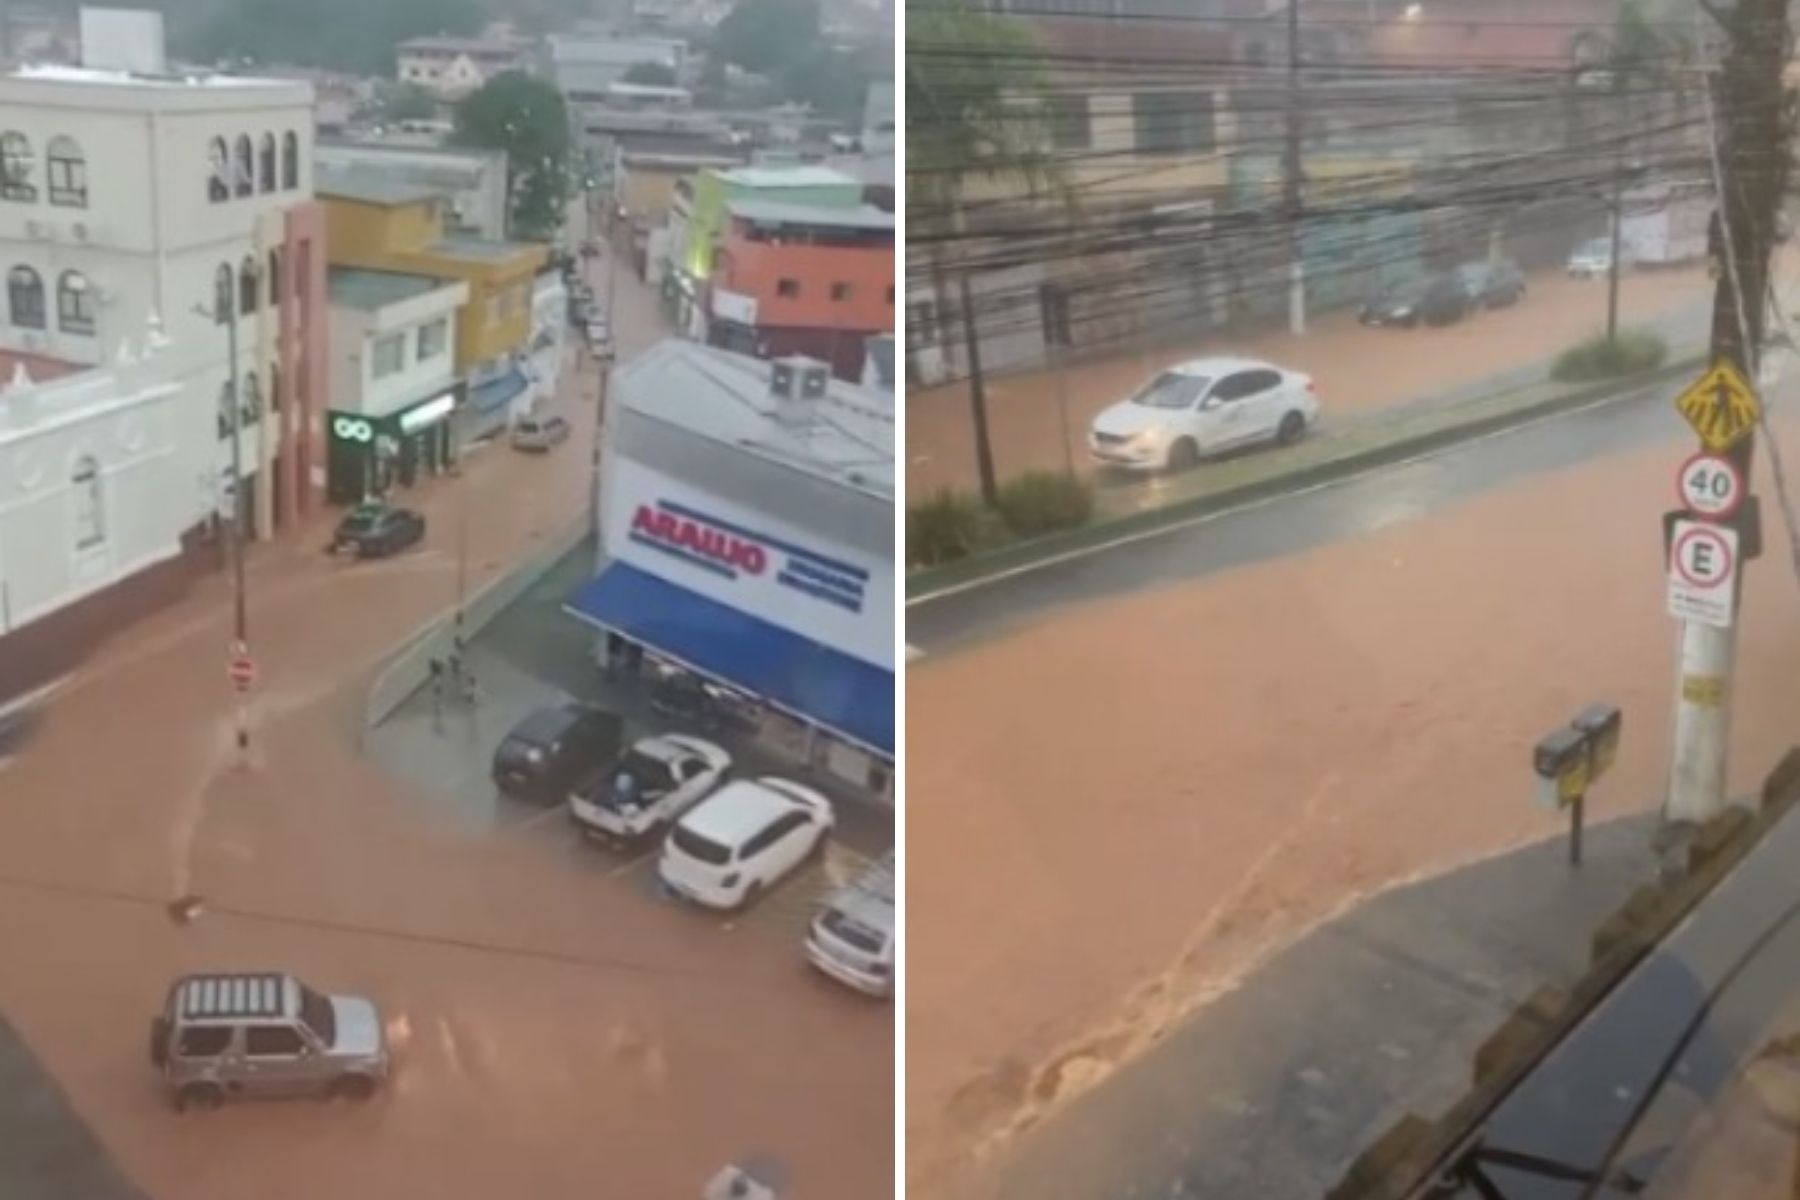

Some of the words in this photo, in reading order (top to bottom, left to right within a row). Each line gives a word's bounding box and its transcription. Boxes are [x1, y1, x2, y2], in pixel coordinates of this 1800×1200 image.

[1688, 470, 1731, 499] 40
[632, 505, 767, 575] ARAUJO
[1691, 542, 1713, 575] E
